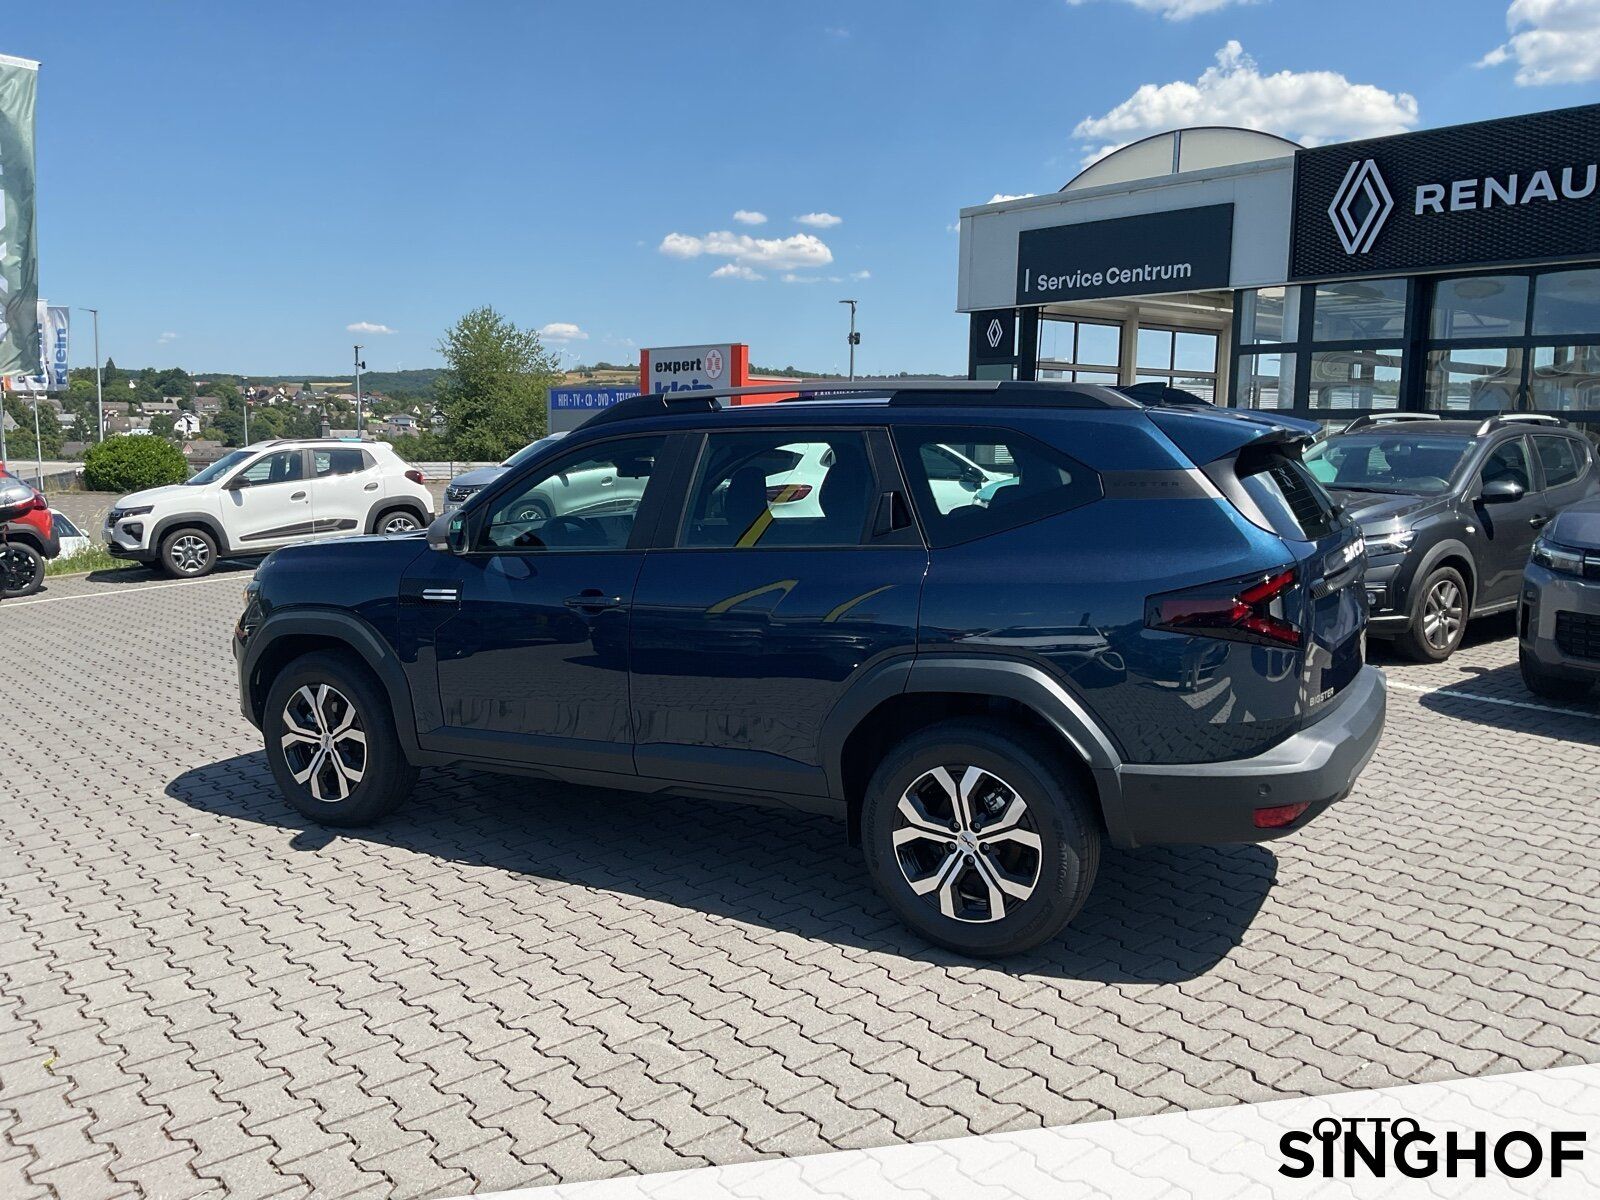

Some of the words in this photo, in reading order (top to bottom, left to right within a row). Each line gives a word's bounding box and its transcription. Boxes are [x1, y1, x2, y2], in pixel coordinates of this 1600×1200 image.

[1414, 164, 1598, 216] RENAU
[1037, 269, 1103, 291] Service
[1105, 262, 1192, 285] Centrum
[654, 358, 702, 375] expert
[572, 393, 581, 407] TV
[585, 393, 593, 407] CD
[597, 393, 609, 407] DVD
[1309, 686, 1334, 707] BIGSTER
